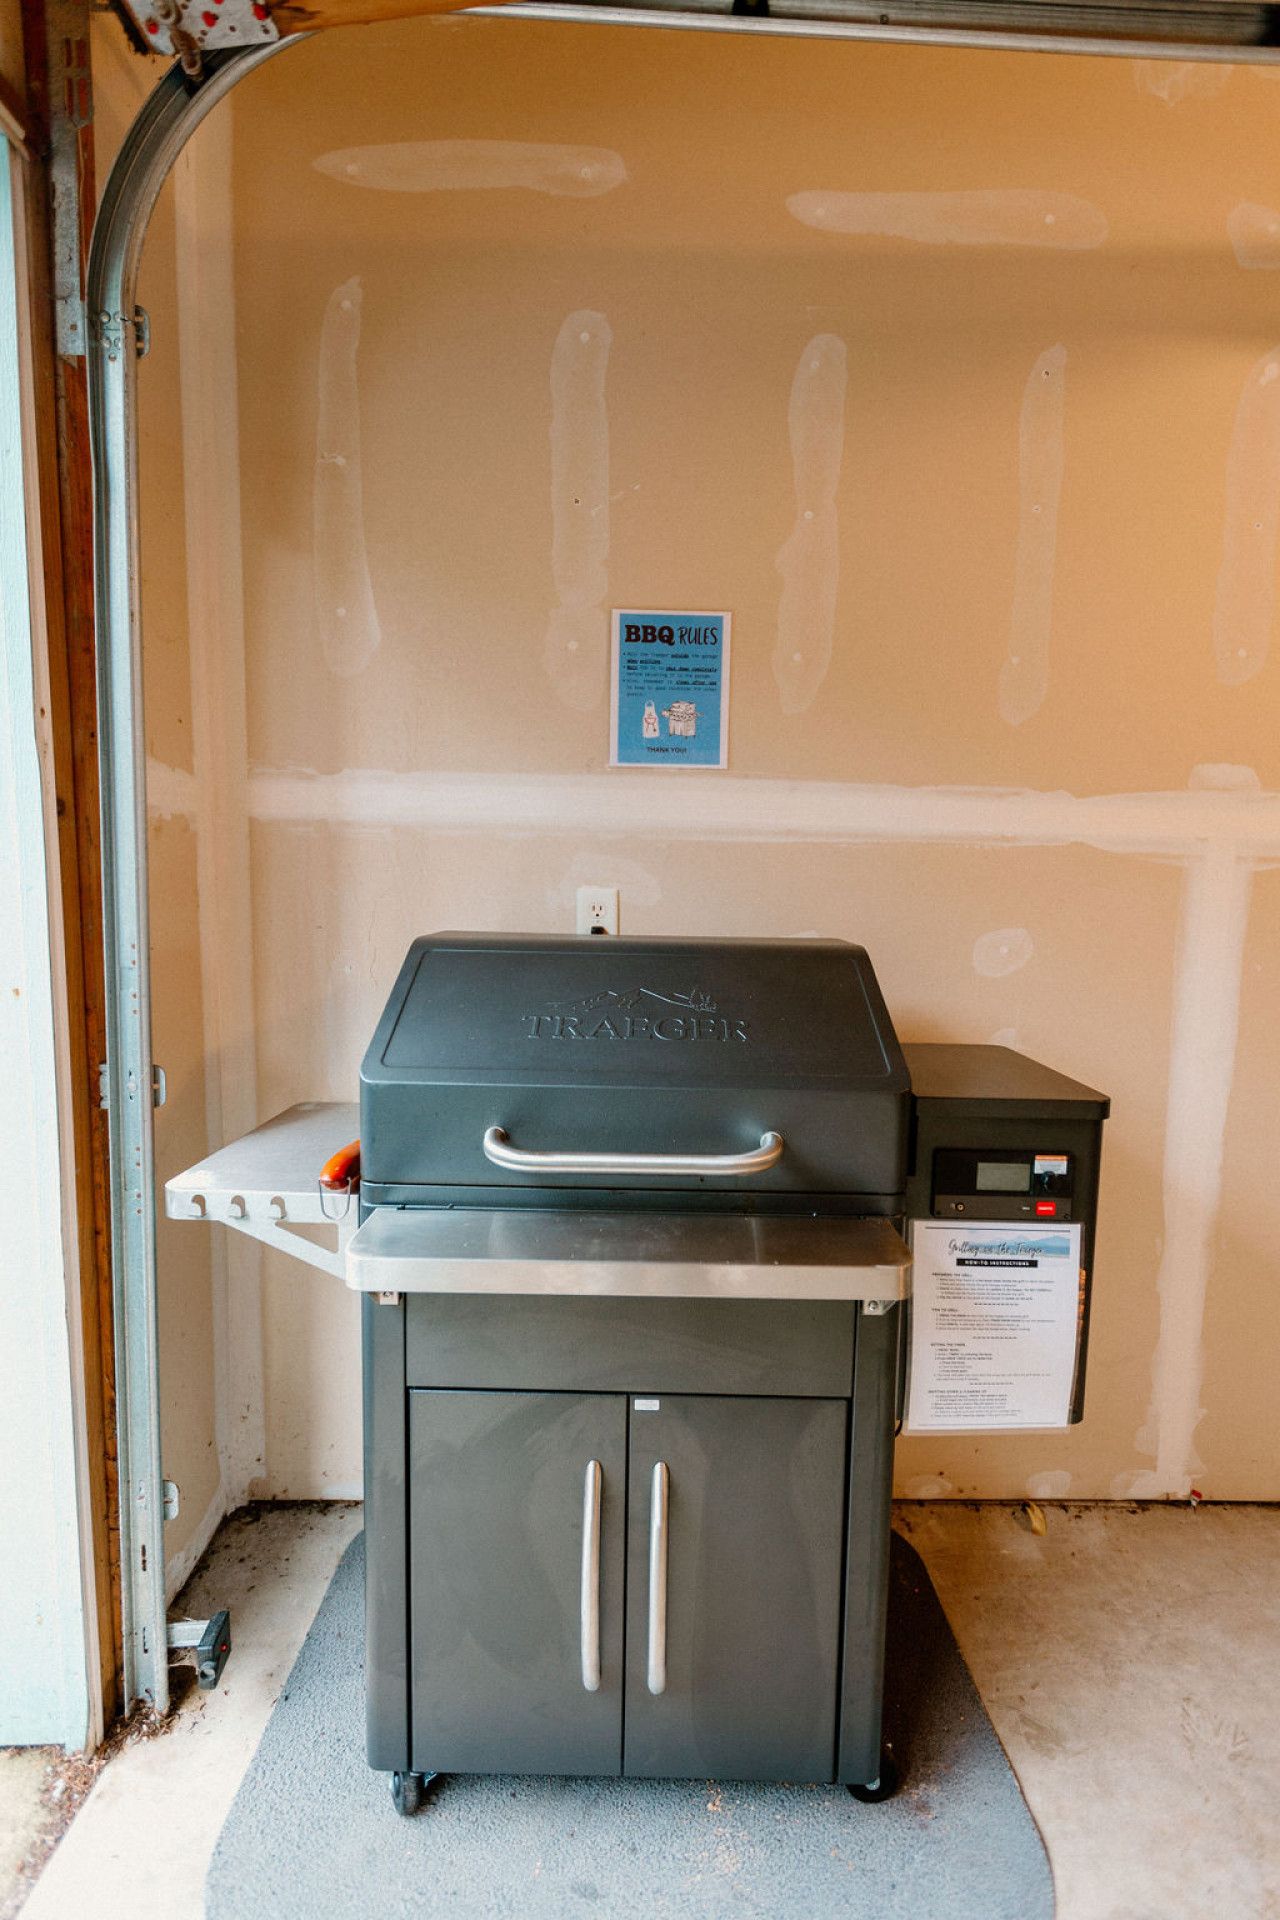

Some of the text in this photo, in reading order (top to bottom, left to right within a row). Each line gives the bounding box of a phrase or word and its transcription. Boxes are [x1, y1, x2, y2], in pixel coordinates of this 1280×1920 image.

[625, 624, 719, 646] BBQ RULES
[647, 746, 669, 754] THANK
[520, 1015, 750, 1042] TRAEGER
